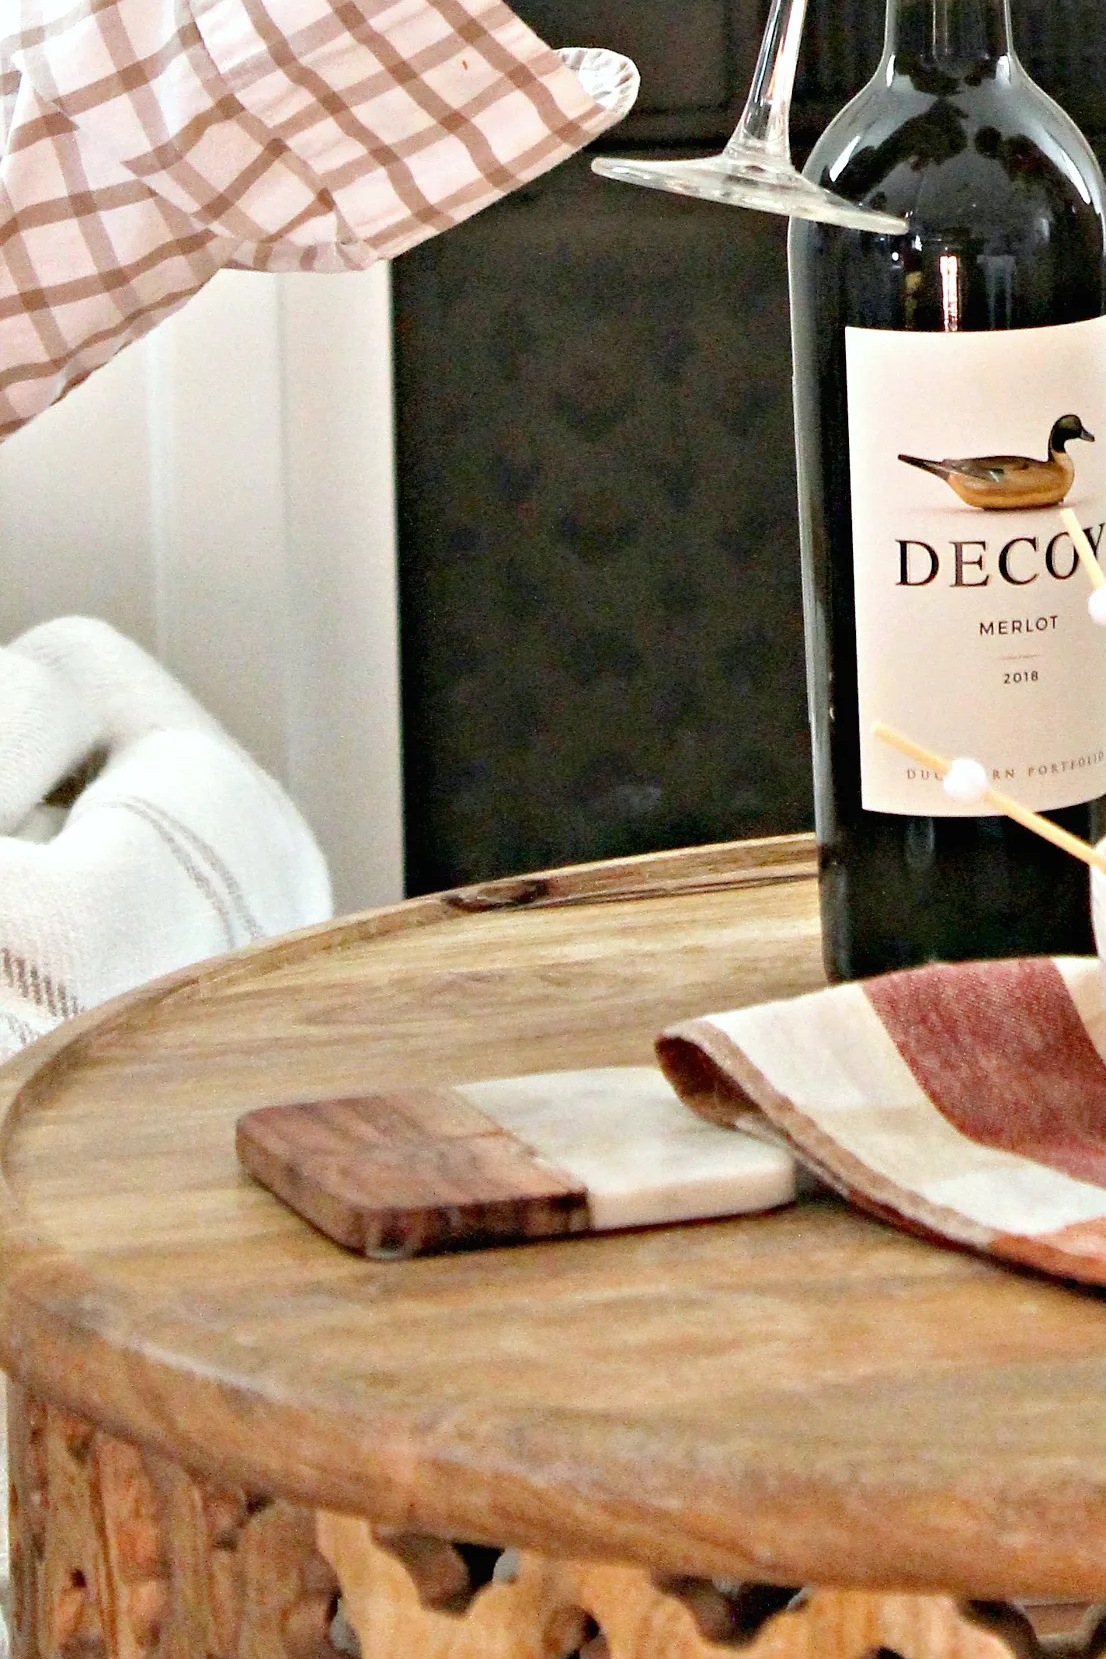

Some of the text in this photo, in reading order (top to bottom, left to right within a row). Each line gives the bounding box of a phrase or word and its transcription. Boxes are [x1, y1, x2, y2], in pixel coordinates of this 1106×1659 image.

[895, 522, 1106, 588] DECOY
[979, 615, 1059, 636] MERLOT
[1003, 670, 1039, 685] 2018
[1027, 750, 1105, 777] PORTFOLIO
